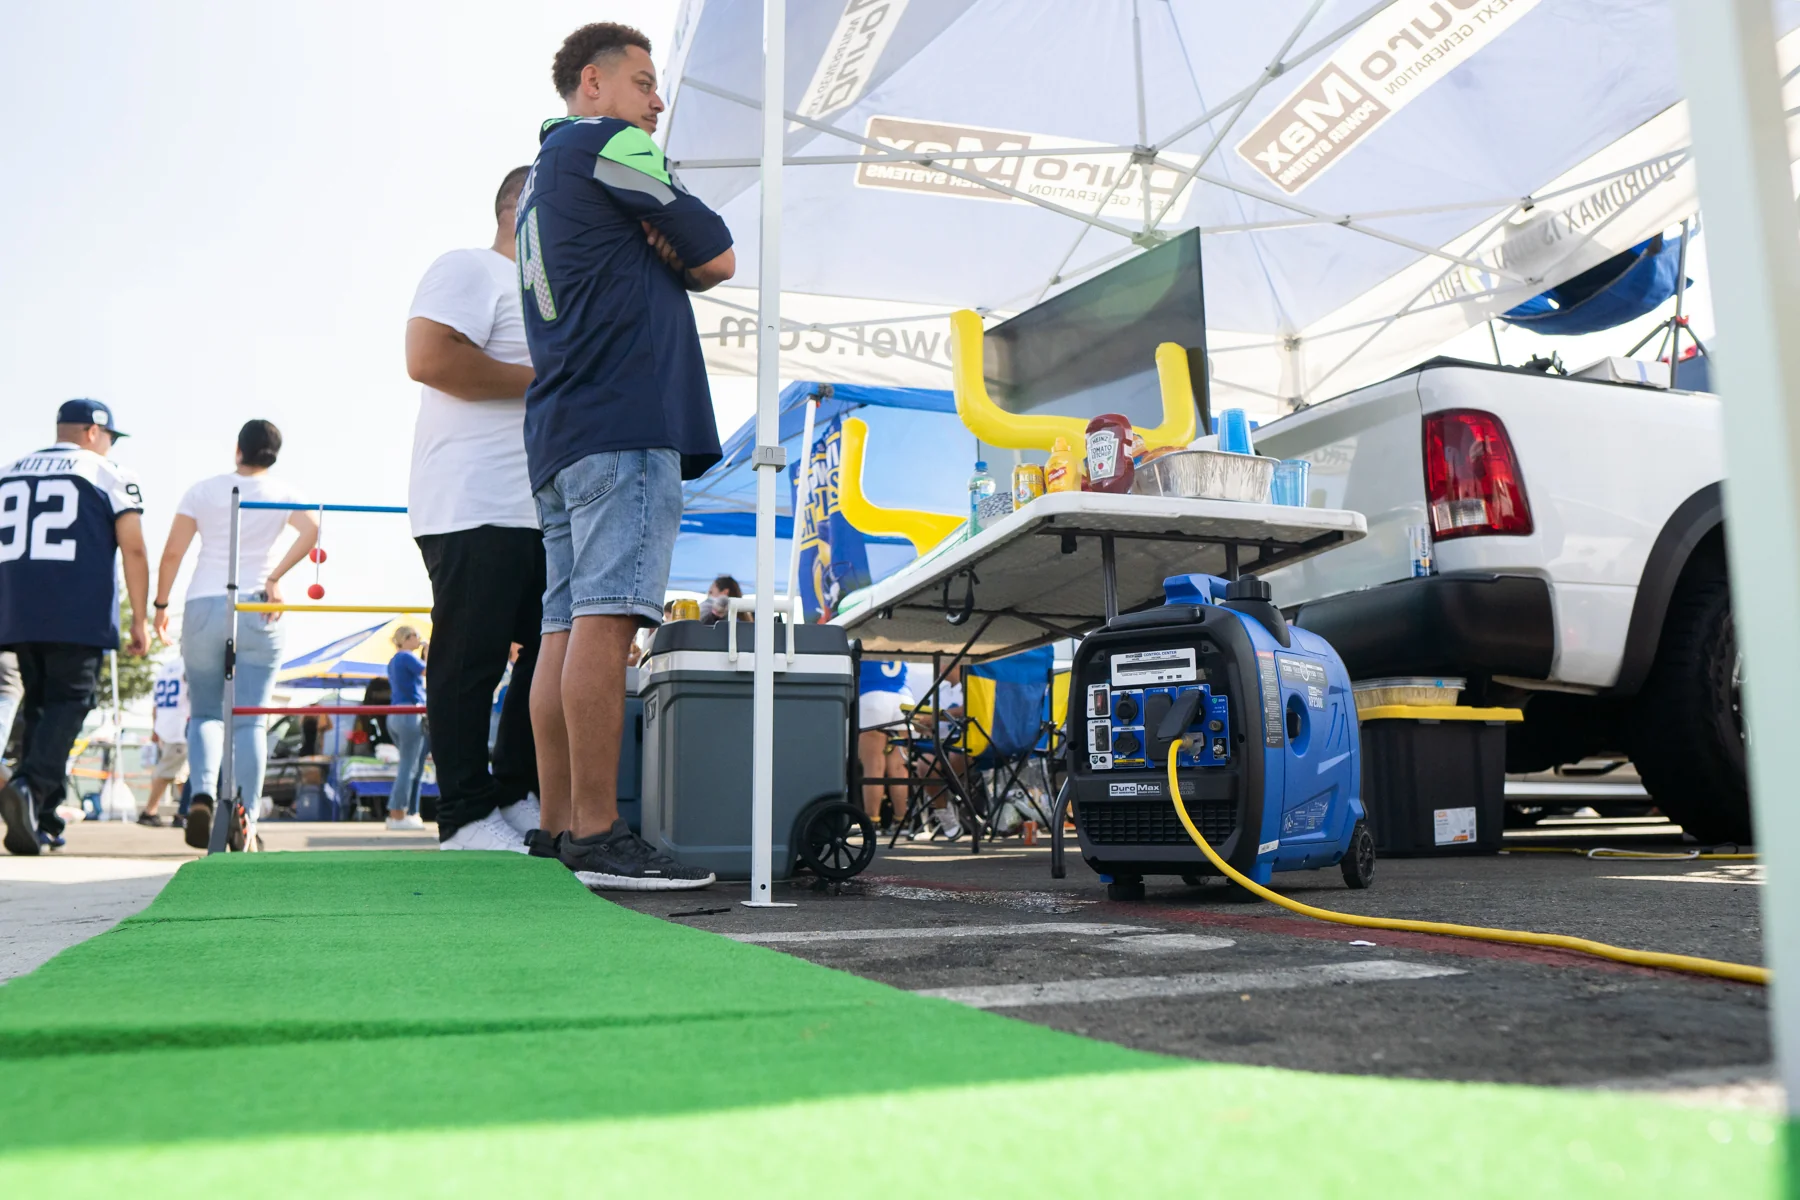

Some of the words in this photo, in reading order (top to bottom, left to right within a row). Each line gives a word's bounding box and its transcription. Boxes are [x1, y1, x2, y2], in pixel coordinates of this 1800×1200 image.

[1092, 436, 1109, 444] HEINZ
[1091, 444, 1112, 454] TOMATO
[1091, 451, 1112, 460] KETCHUP
[0, 479, 79, 563] 92
[154, 679, 179, 707] 22
